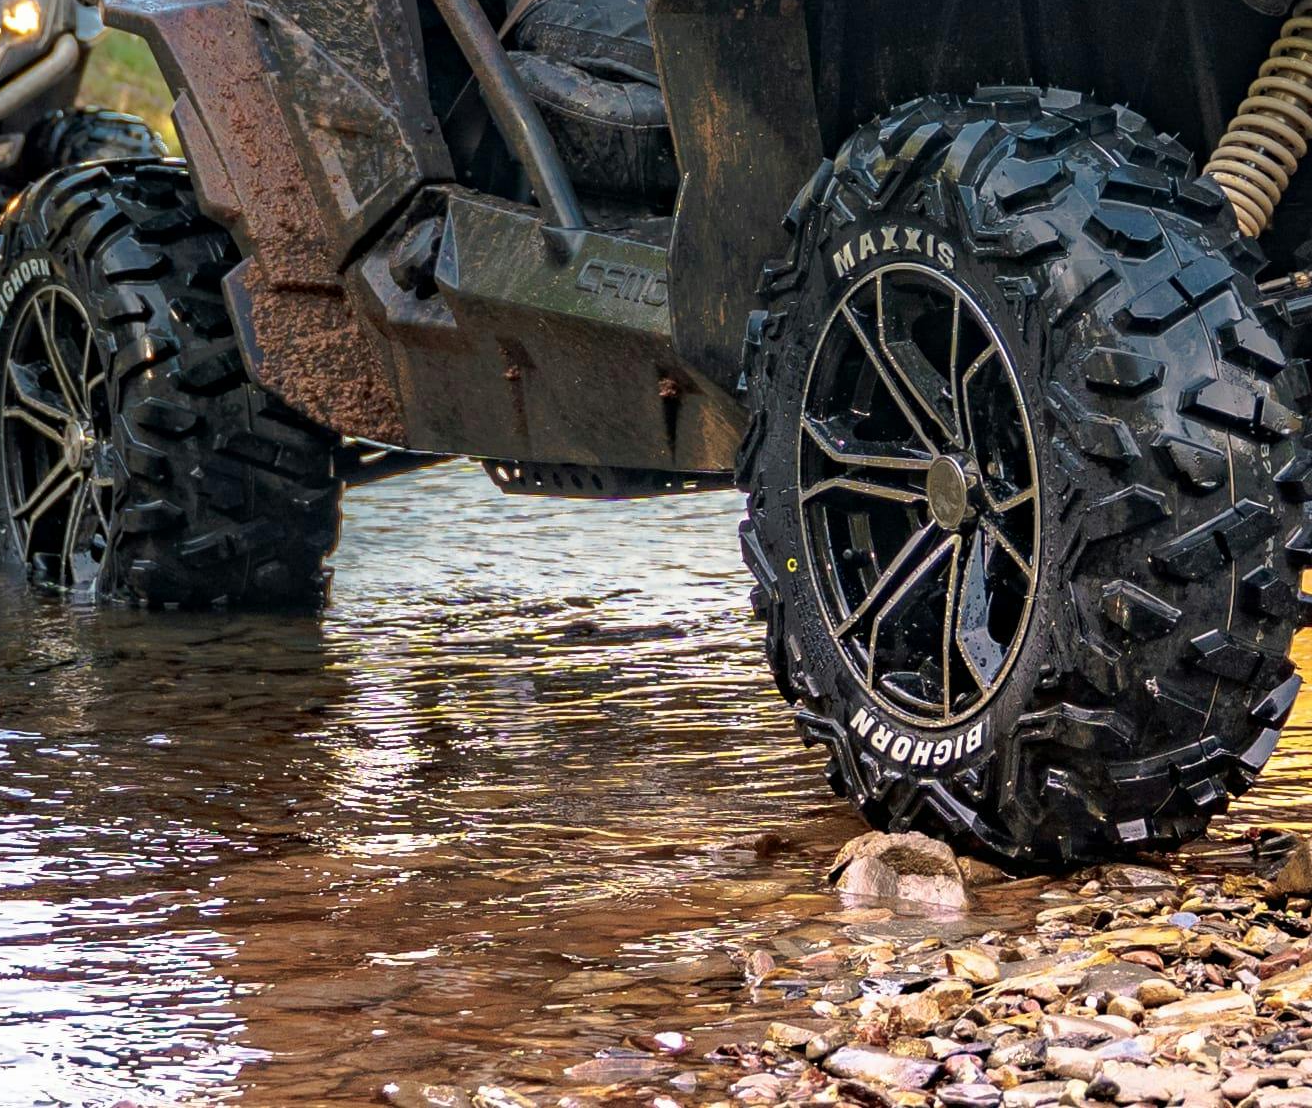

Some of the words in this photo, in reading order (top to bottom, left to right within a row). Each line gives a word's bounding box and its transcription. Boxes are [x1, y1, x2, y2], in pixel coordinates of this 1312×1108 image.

[833, 225, 955, 278] MAXXIS
[575, 258, 667, 307] CFMO
[850, 708, 983, 765] BIGHORN
